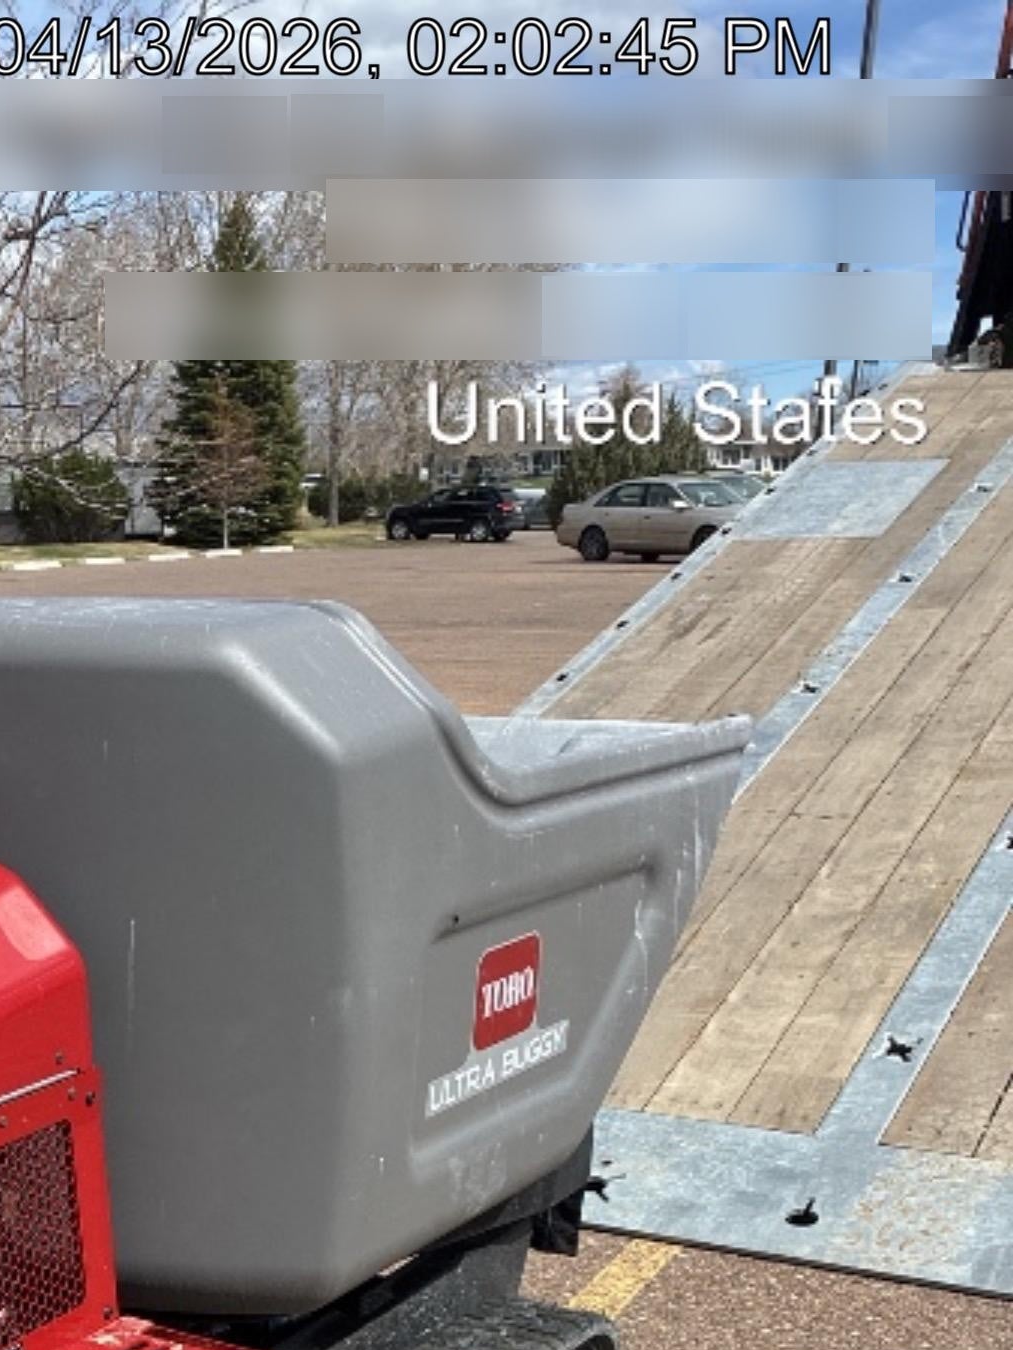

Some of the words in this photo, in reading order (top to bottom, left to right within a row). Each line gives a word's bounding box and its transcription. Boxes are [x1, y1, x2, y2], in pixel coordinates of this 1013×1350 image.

[481, 965, 535, 1020] TORO
[428, 1057, 496, 1112] ULTRA
[501, 1018, 569, 1077] BUGGY
